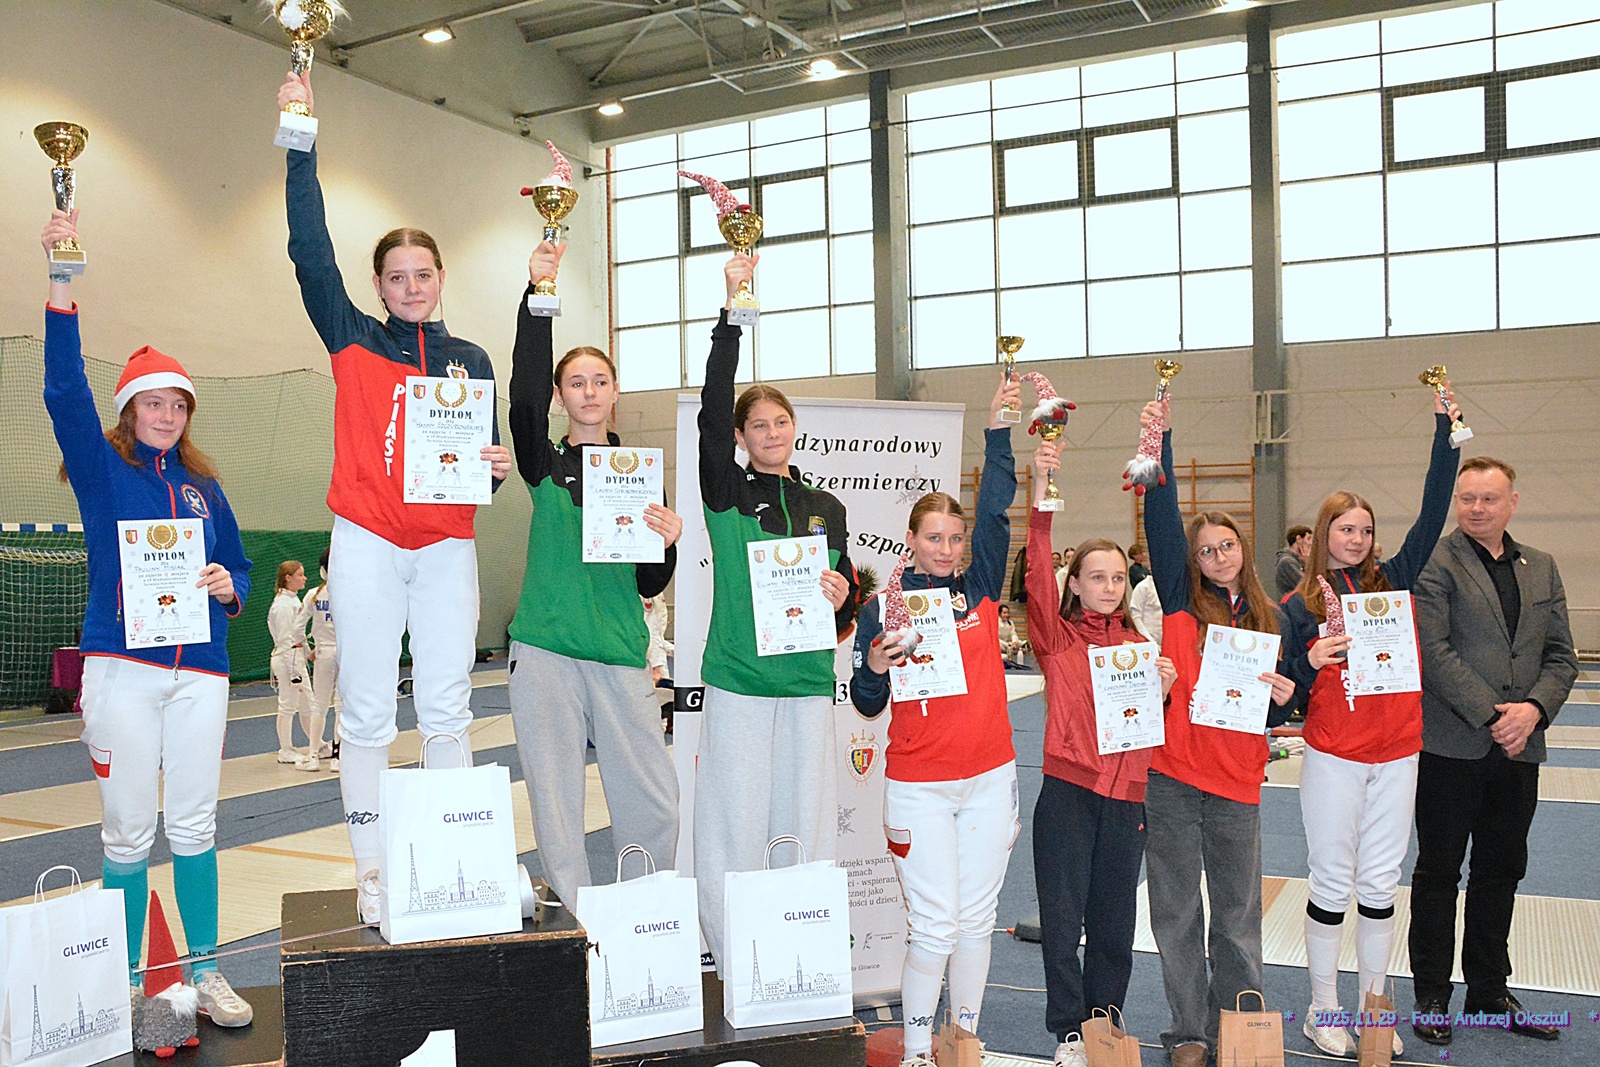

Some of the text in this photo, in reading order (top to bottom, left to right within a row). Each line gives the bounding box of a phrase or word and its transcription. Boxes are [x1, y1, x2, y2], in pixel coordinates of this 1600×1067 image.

[429, 409, 472, 420] DYPLOM
[384, 382, 406, 477] PIAST
[795, 432, 942, 458] dzynarodowy
[605, 476, 645, 484] DYPLOM
[801, 471, 941, 493] Szermierczy
[144, 551, 185, 562] DYPLOM
[771, 567, 811, 578] DYPLOM
[914, 616, 937, 626] PLOM
[1363, 617, 1397, 627] DYPLOM
[1223, 652, 1259, 665] DYPLOM
[1110, 670, 1145, 682] DYPLOM
[443, 810, 494, 824] GLIWICE
[840, 856, 894, 868] dzięki wsparci
[868, 887, 884, 898] jako
[876, 894, 899, 904] dzieci
[784, 908, 831, 921] GLIWICE
[634, 920, 680, 934] GLIWICE
[63, 937, 109, 958] GLIWICE
[858, 963, 881, 971] Gliwice
